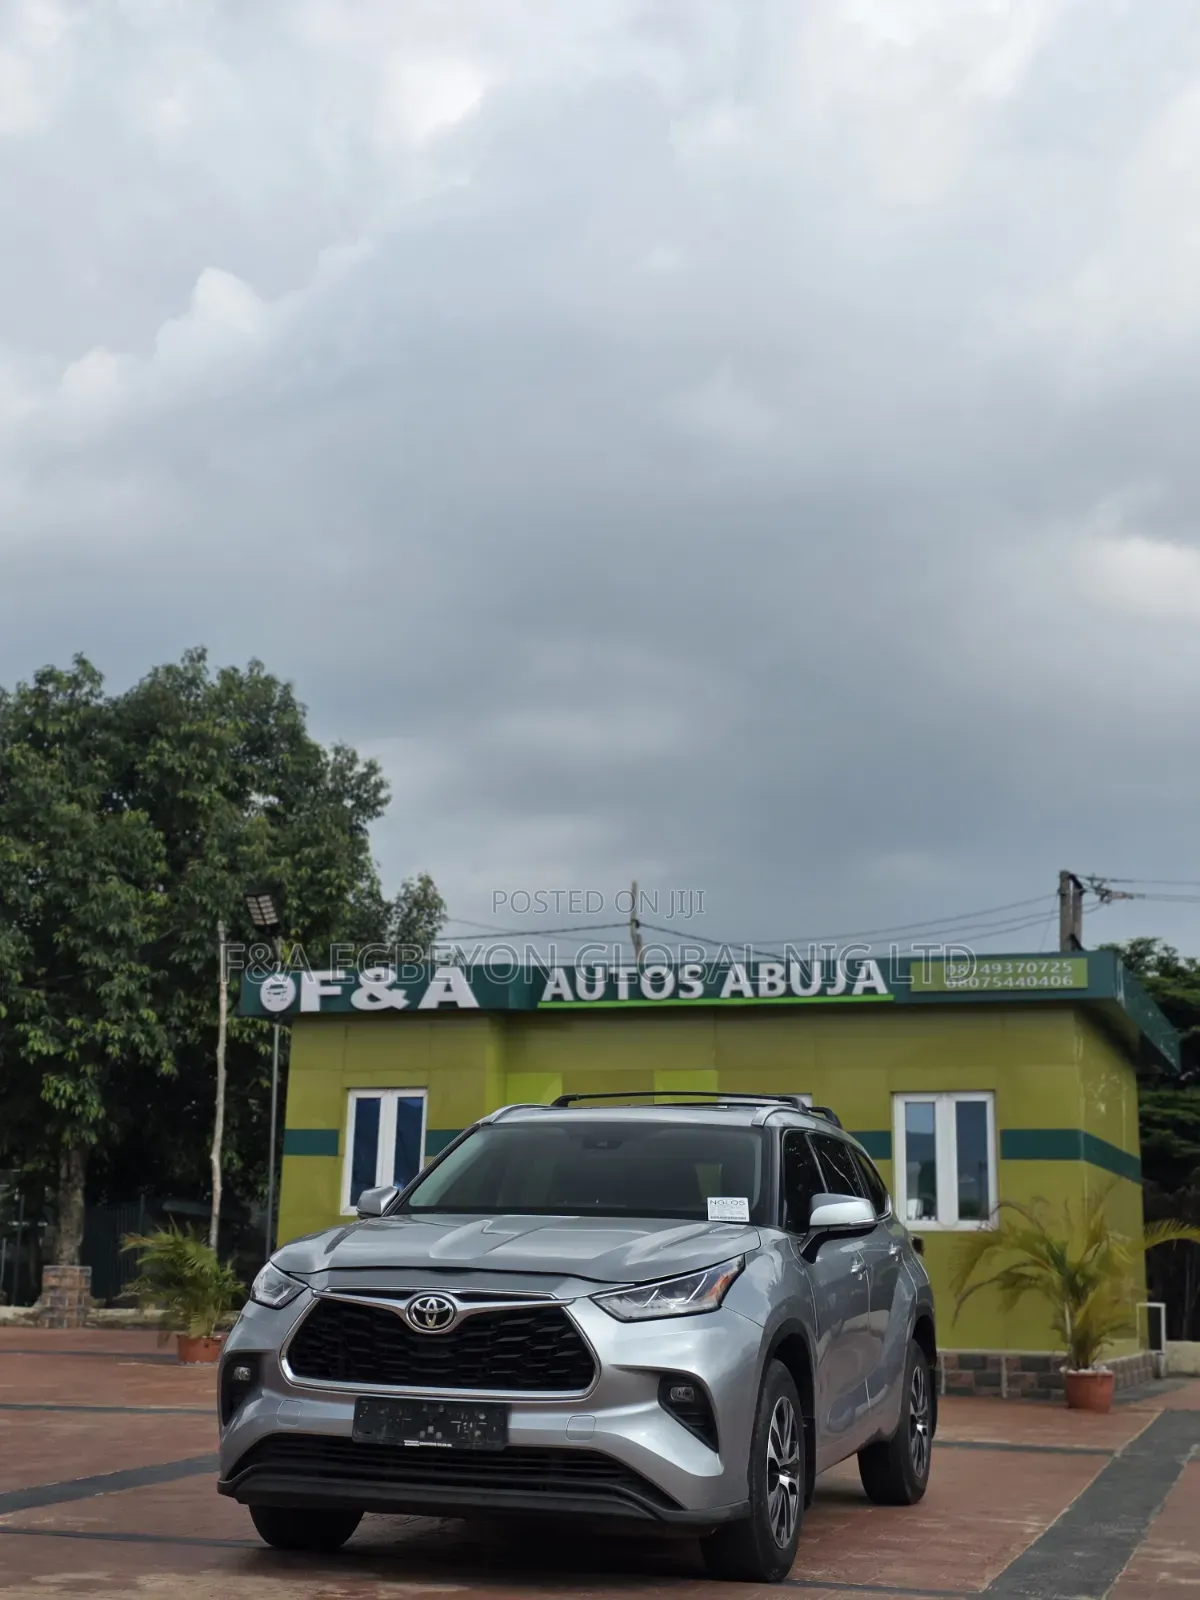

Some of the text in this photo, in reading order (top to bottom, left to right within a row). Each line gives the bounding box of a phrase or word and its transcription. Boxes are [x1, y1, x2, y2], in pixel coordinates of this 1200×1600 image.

[540, 963, 706, 1002] AUTOS
[719, 958, 889, 999] ABUJA
[945, 961, 1073, 976] 0849370725
